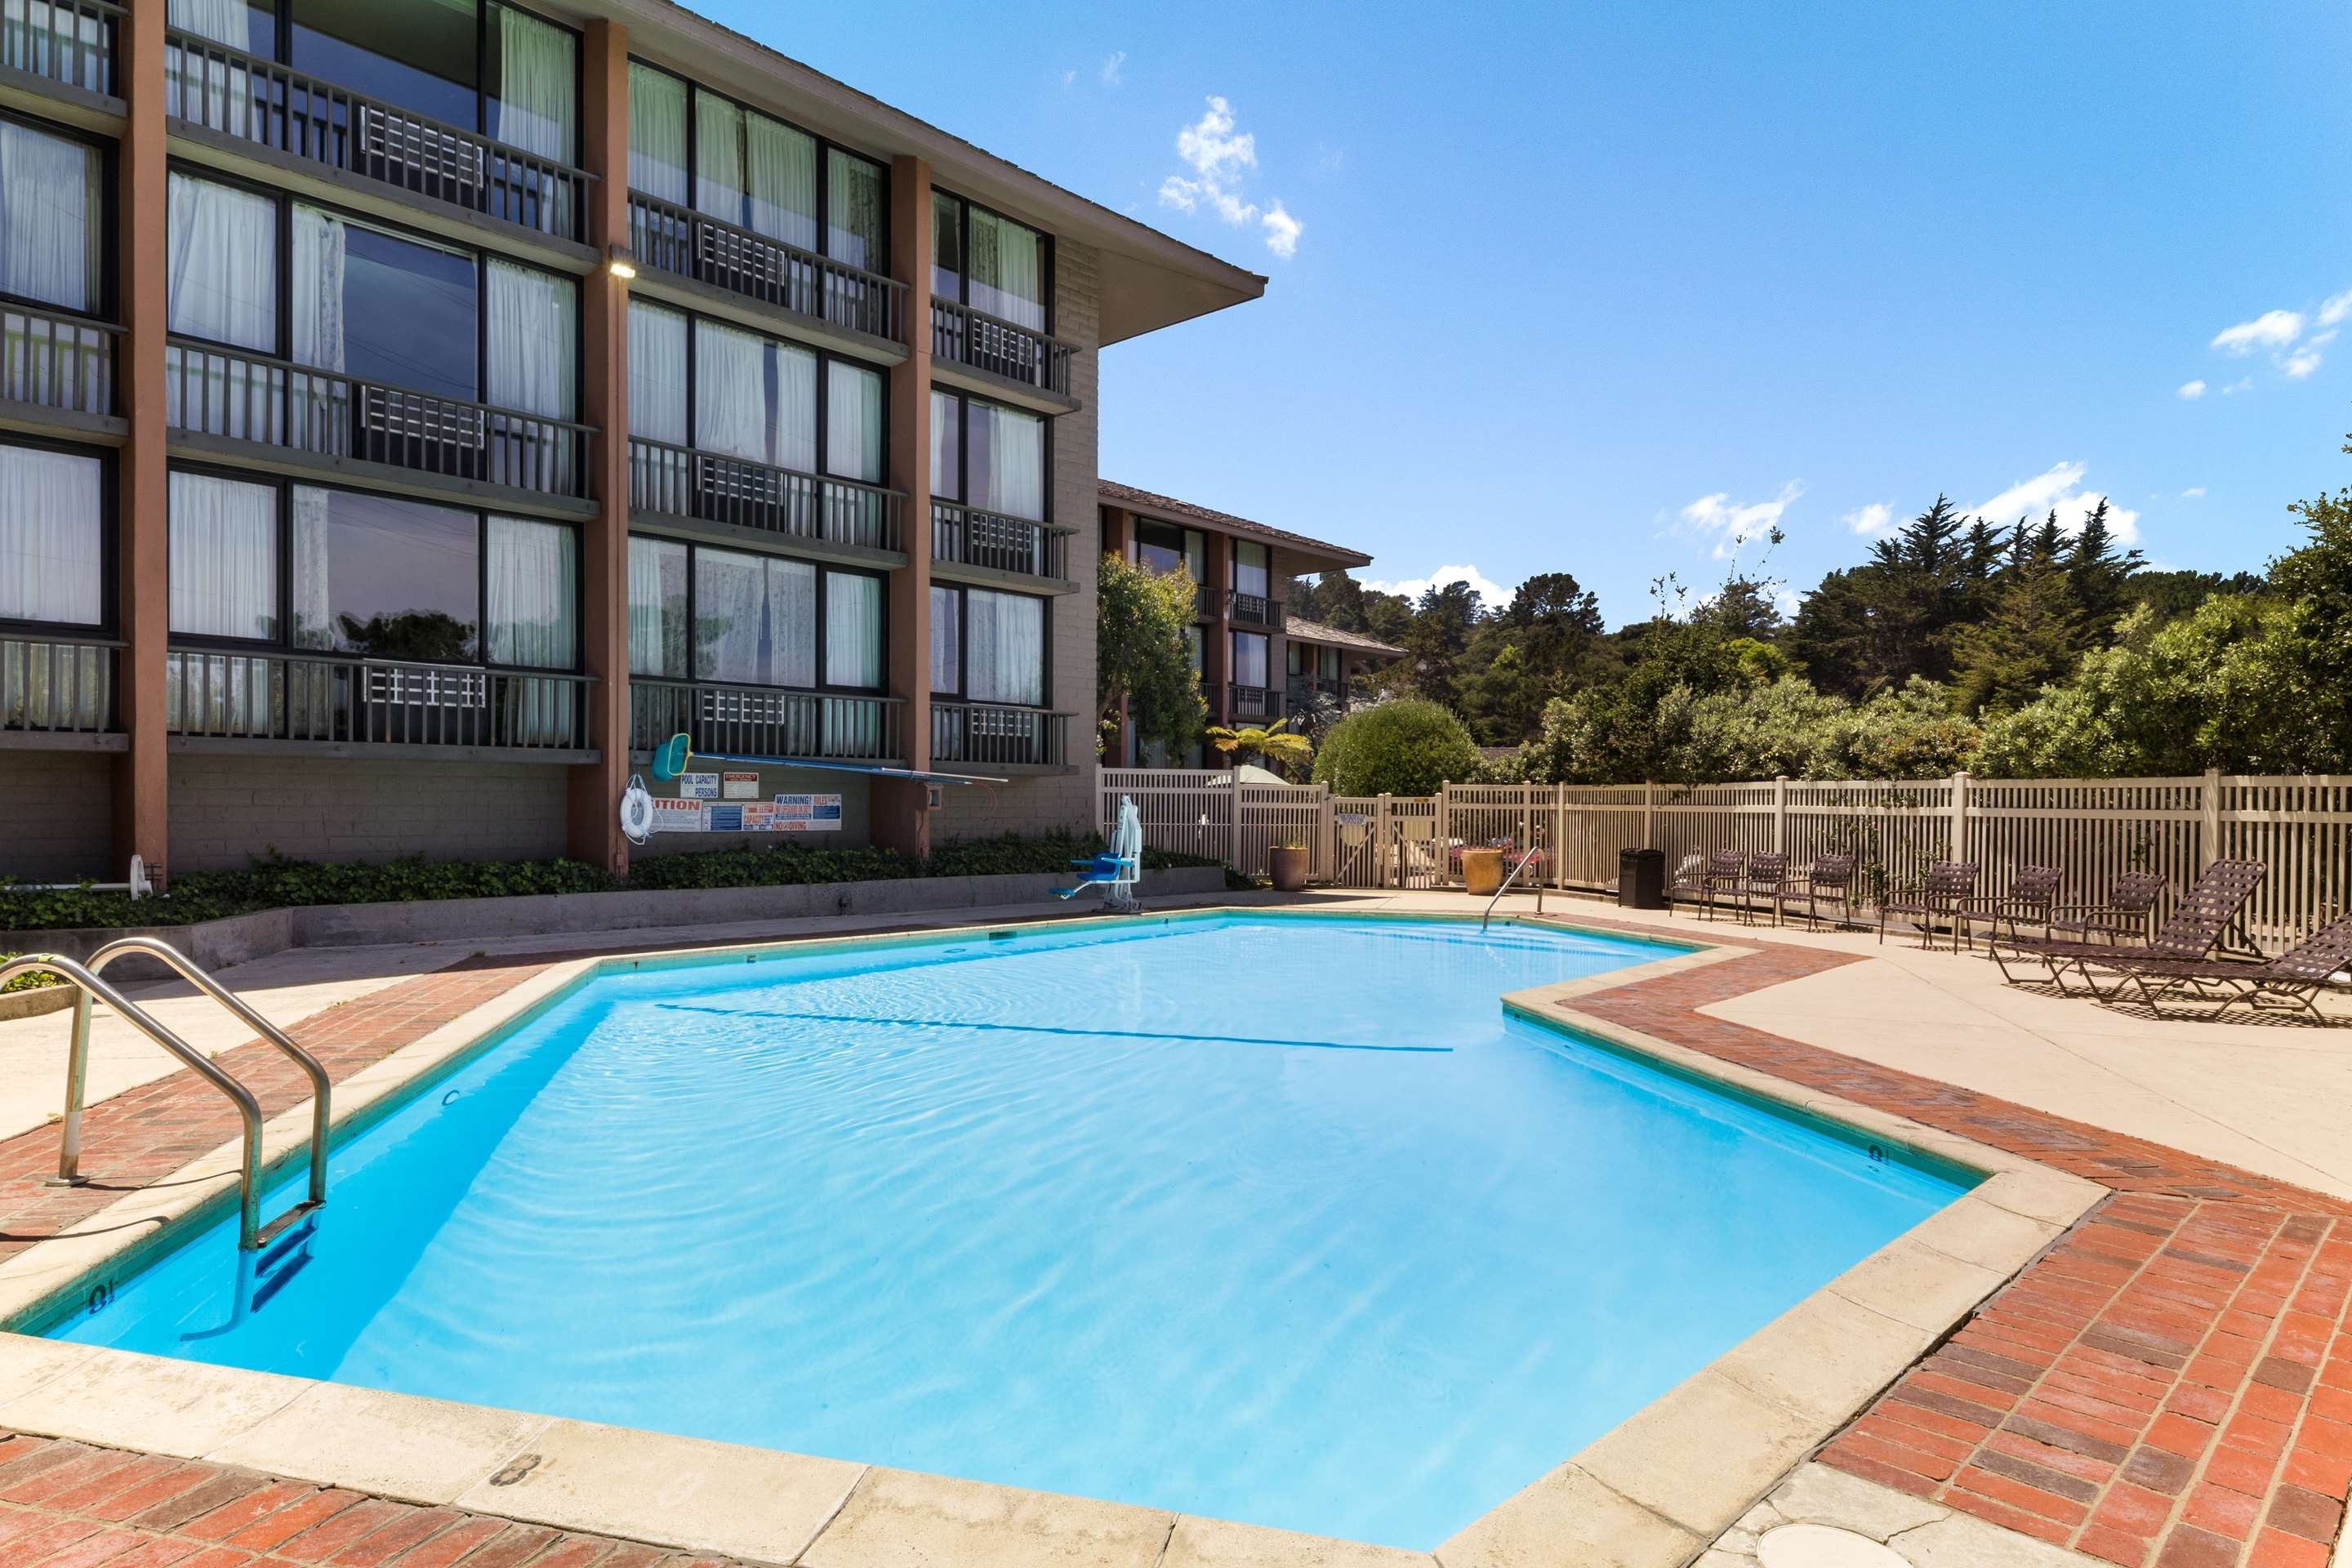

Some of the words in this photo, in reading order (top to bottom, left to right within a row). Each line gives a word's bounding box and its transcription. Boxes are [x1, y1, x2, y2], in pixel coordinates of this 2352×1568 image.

[682, 775, 693, 784] POOL
[696, 775, 717, 784] CAPACITY
[695, 788, 717, 797] PERSONS
[777, 795, 812, 804] WARNING!
